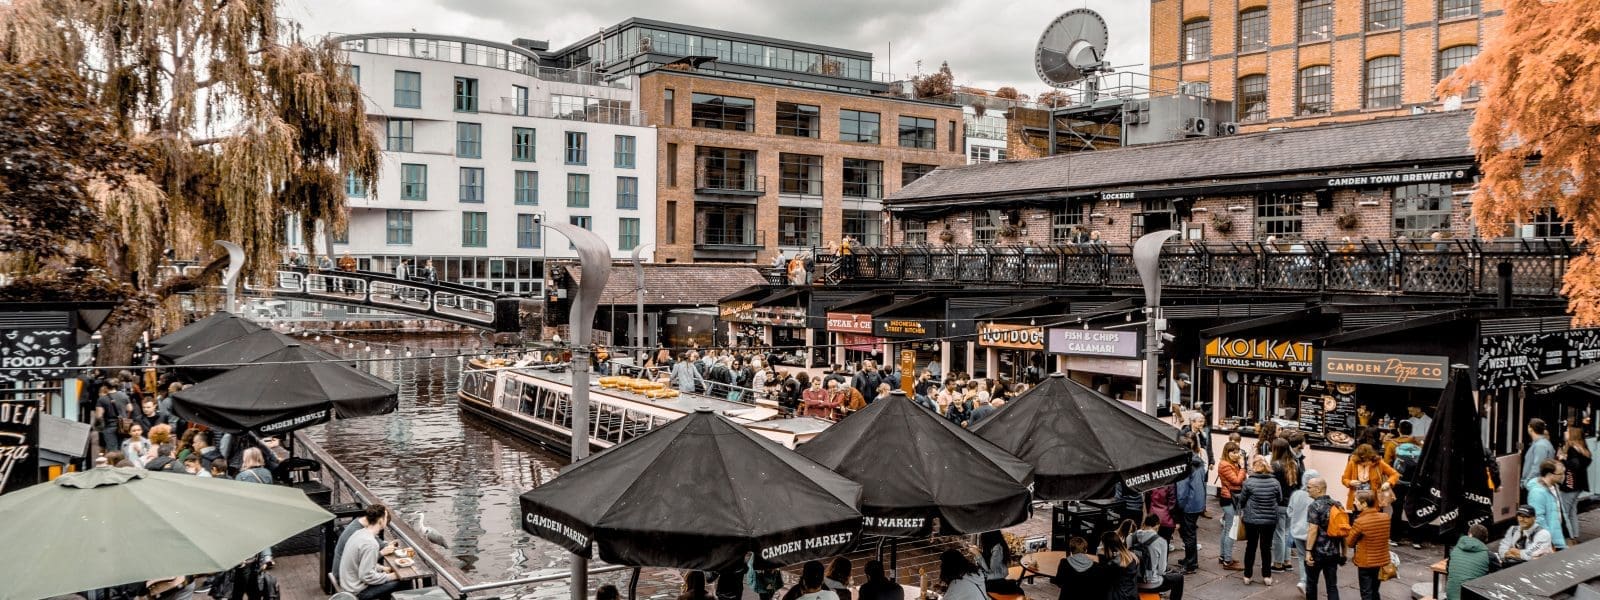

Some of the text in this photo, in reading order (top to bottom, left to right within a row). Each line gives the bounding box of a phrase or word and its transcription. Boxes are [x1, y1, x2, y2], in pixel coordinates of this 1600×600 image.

[1328, 171, 1453, 186] CAMDEN TOWN BREWERY
[1101, 192, 1135, 200] LOCKSIDE
[827, 319, 852, 328] STEAK
[1064, 331, 1119, 342] FISH & CHIPS
[1069, 343, 1114, 353] CALAMARI
[2, 356, 46, 367] FOOD
[1227, 358, 1250, 366] ROLLS
[1256, 360, 1278, 368] INDIA
[1489, 356, 1528, 369] WEST YARD
[1327, 358, 1442, 383] CAMDEN Pizza CO
[260, 410, 326, 432] CAMDEN MARKET
[1125, 464, 1187, 487] CAMDEN MARKET
[878, 518, 925, 528] MARKET
[526, 513, 588, 548] CAMDEN MARKET
[761, 533, 853, 560] CAMDEN MARKET
